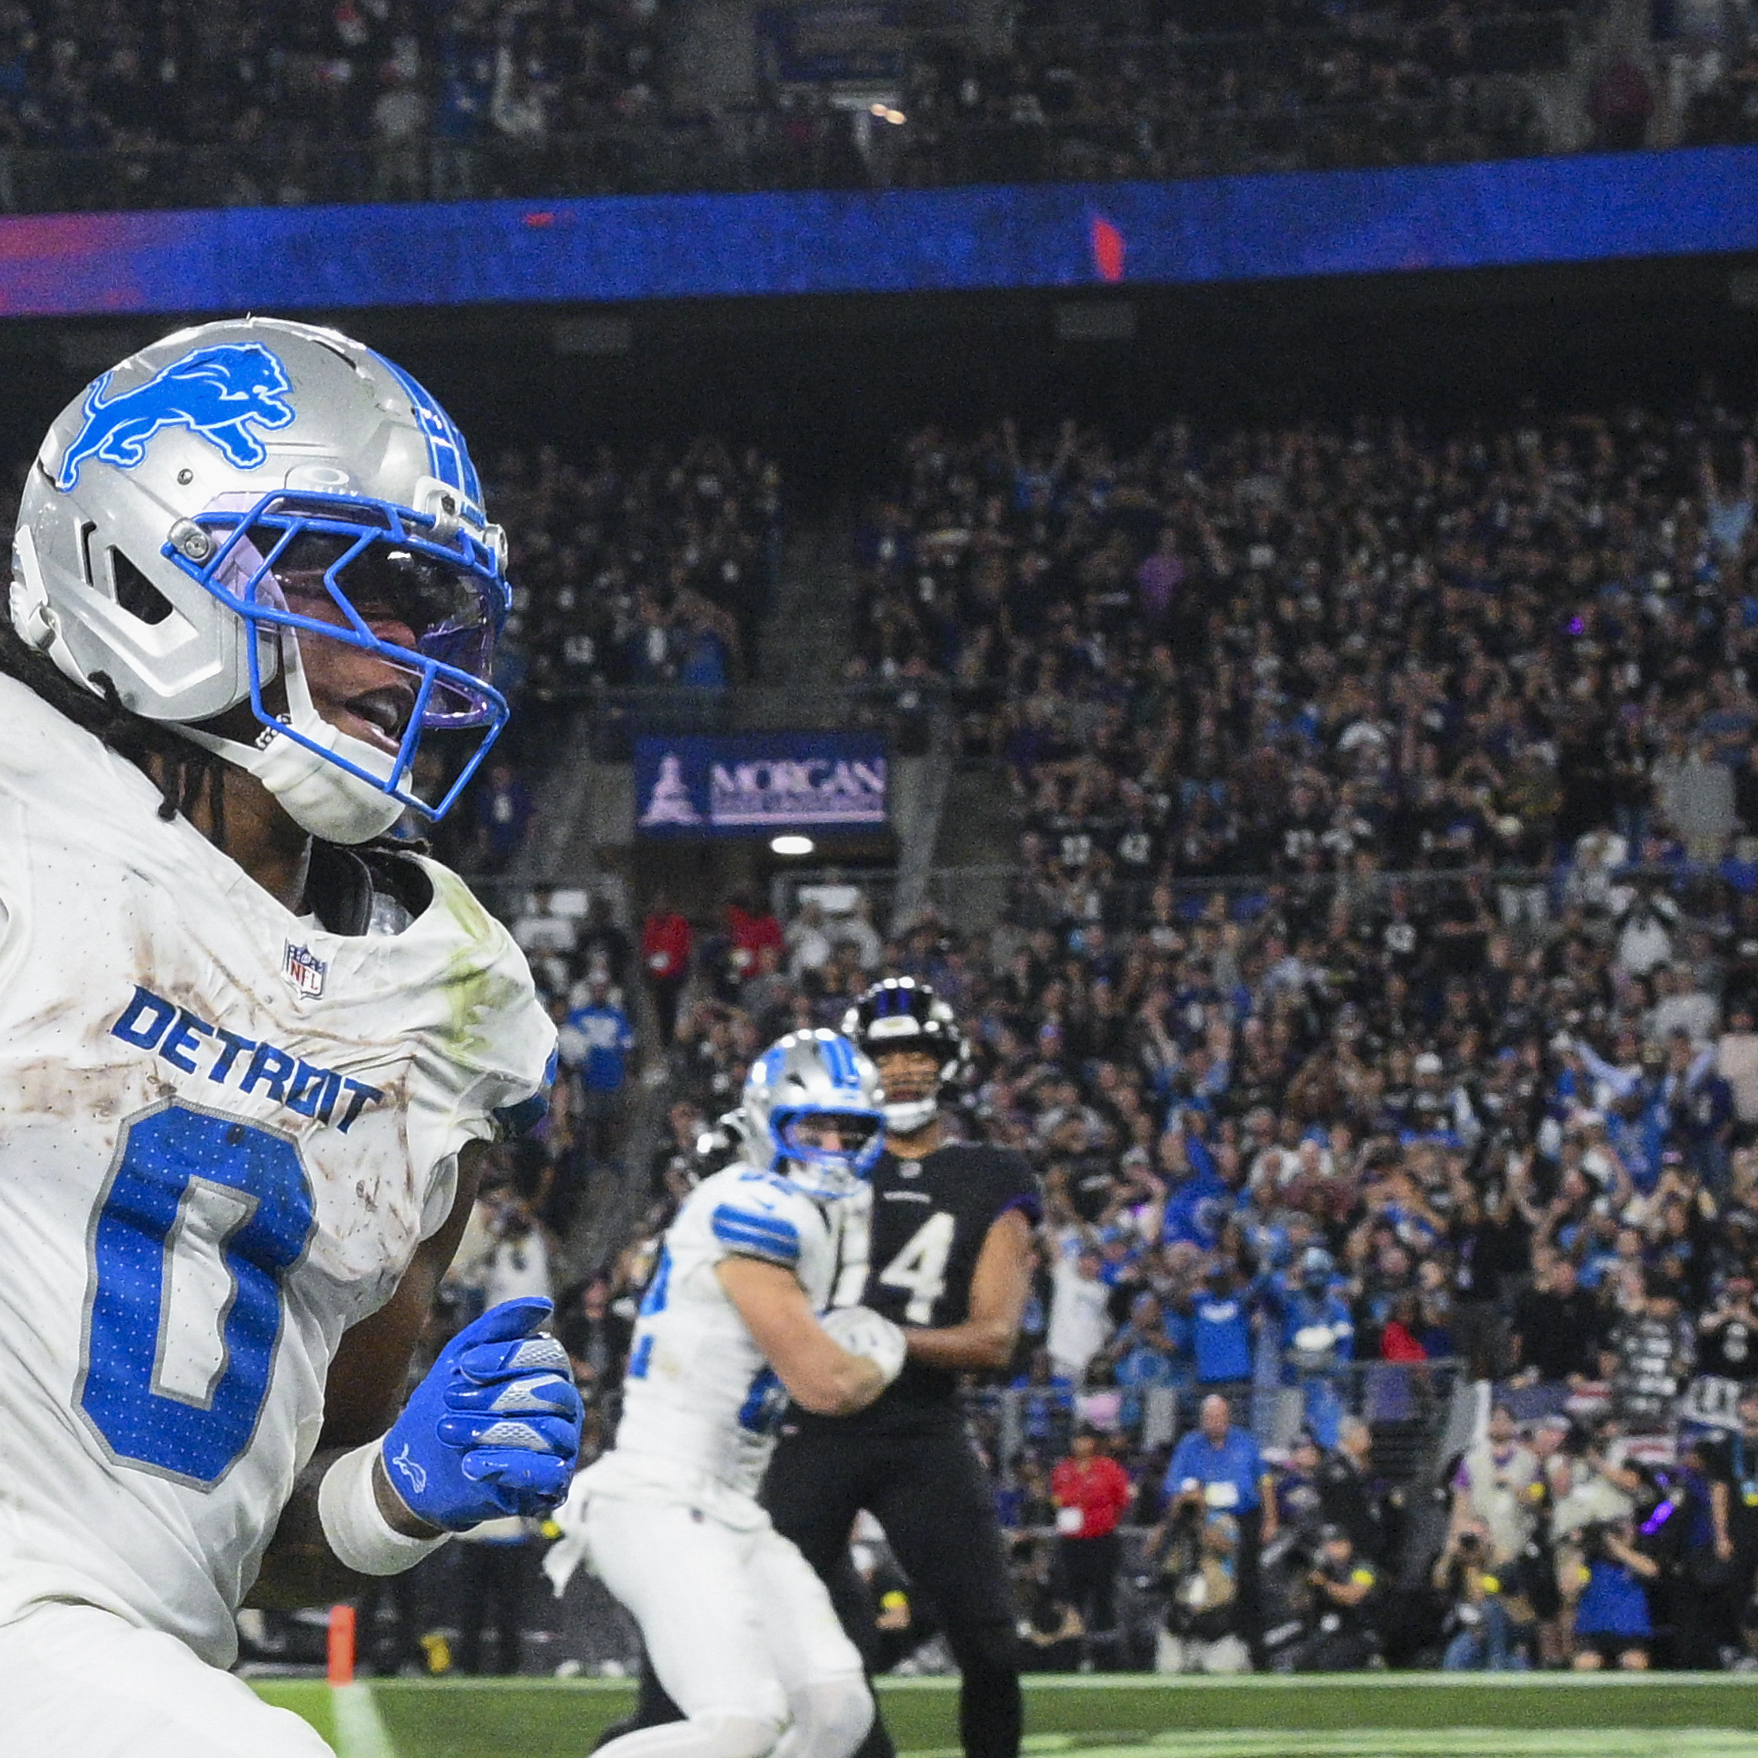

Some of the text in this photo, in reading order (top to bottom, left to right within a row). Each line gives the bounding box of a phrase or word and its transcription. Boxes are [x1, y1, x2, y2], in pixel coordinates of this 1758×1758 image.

[710, 757, 886, 794] MORGAN
[290, 959, 319, 991] NFL
[110, 983, 385, 1135] DETROIT
[71, 1097, 319, 1495] 0
